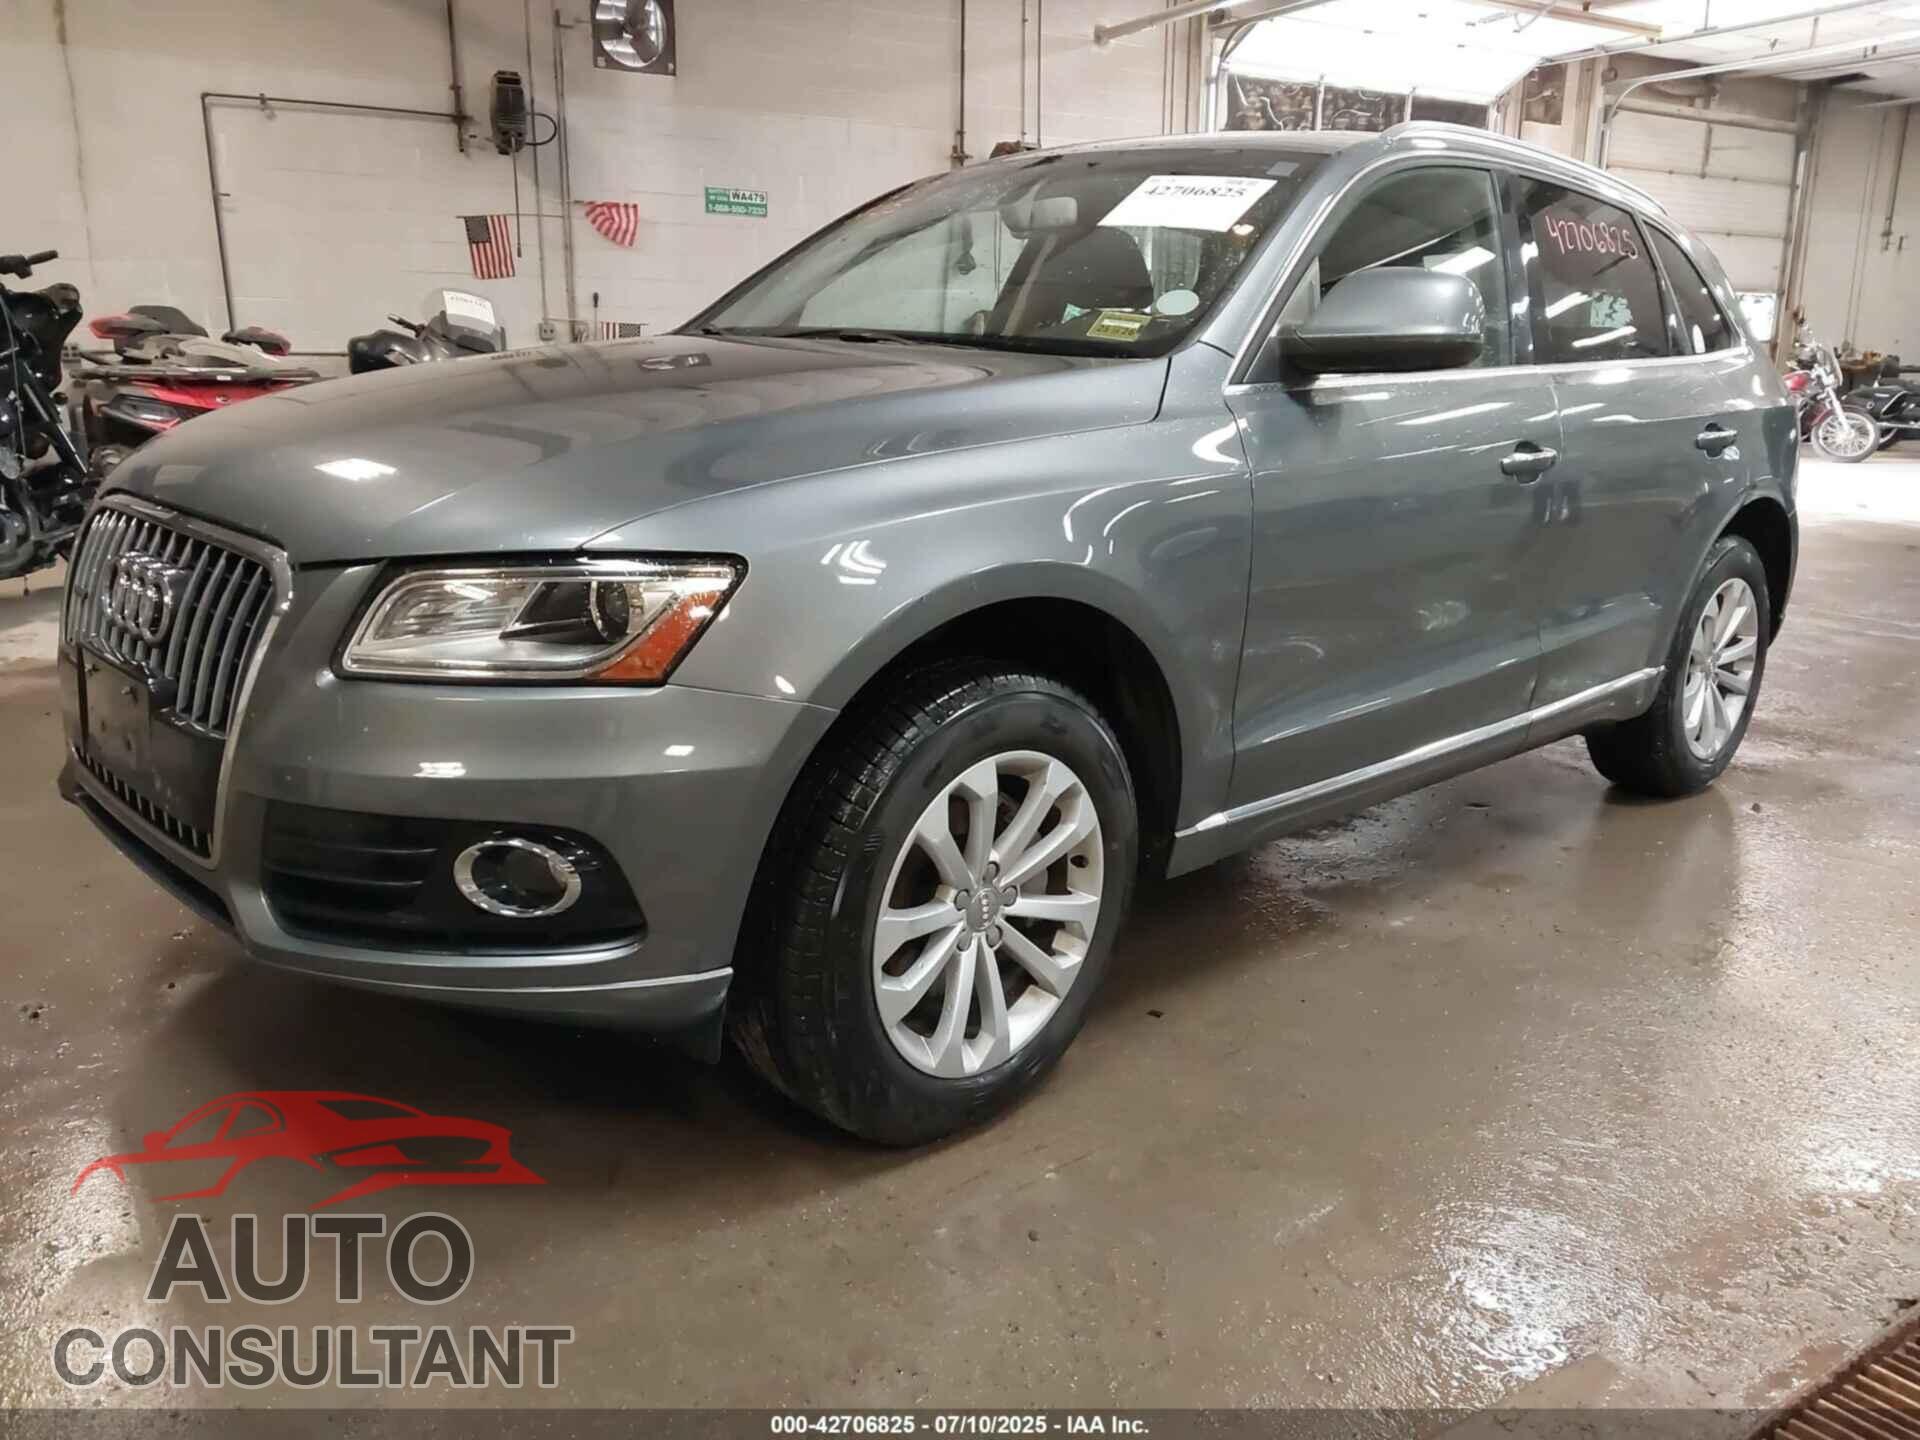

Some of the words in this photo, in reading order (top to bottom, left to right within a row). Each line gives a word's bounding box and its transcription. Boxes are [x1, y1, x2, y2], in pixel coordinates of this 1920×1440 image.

[732, 191, 765, 202] WA479
[1145, 185, 1247, 198] 42706825
[1545, 215, 1638, 259] 42706825
